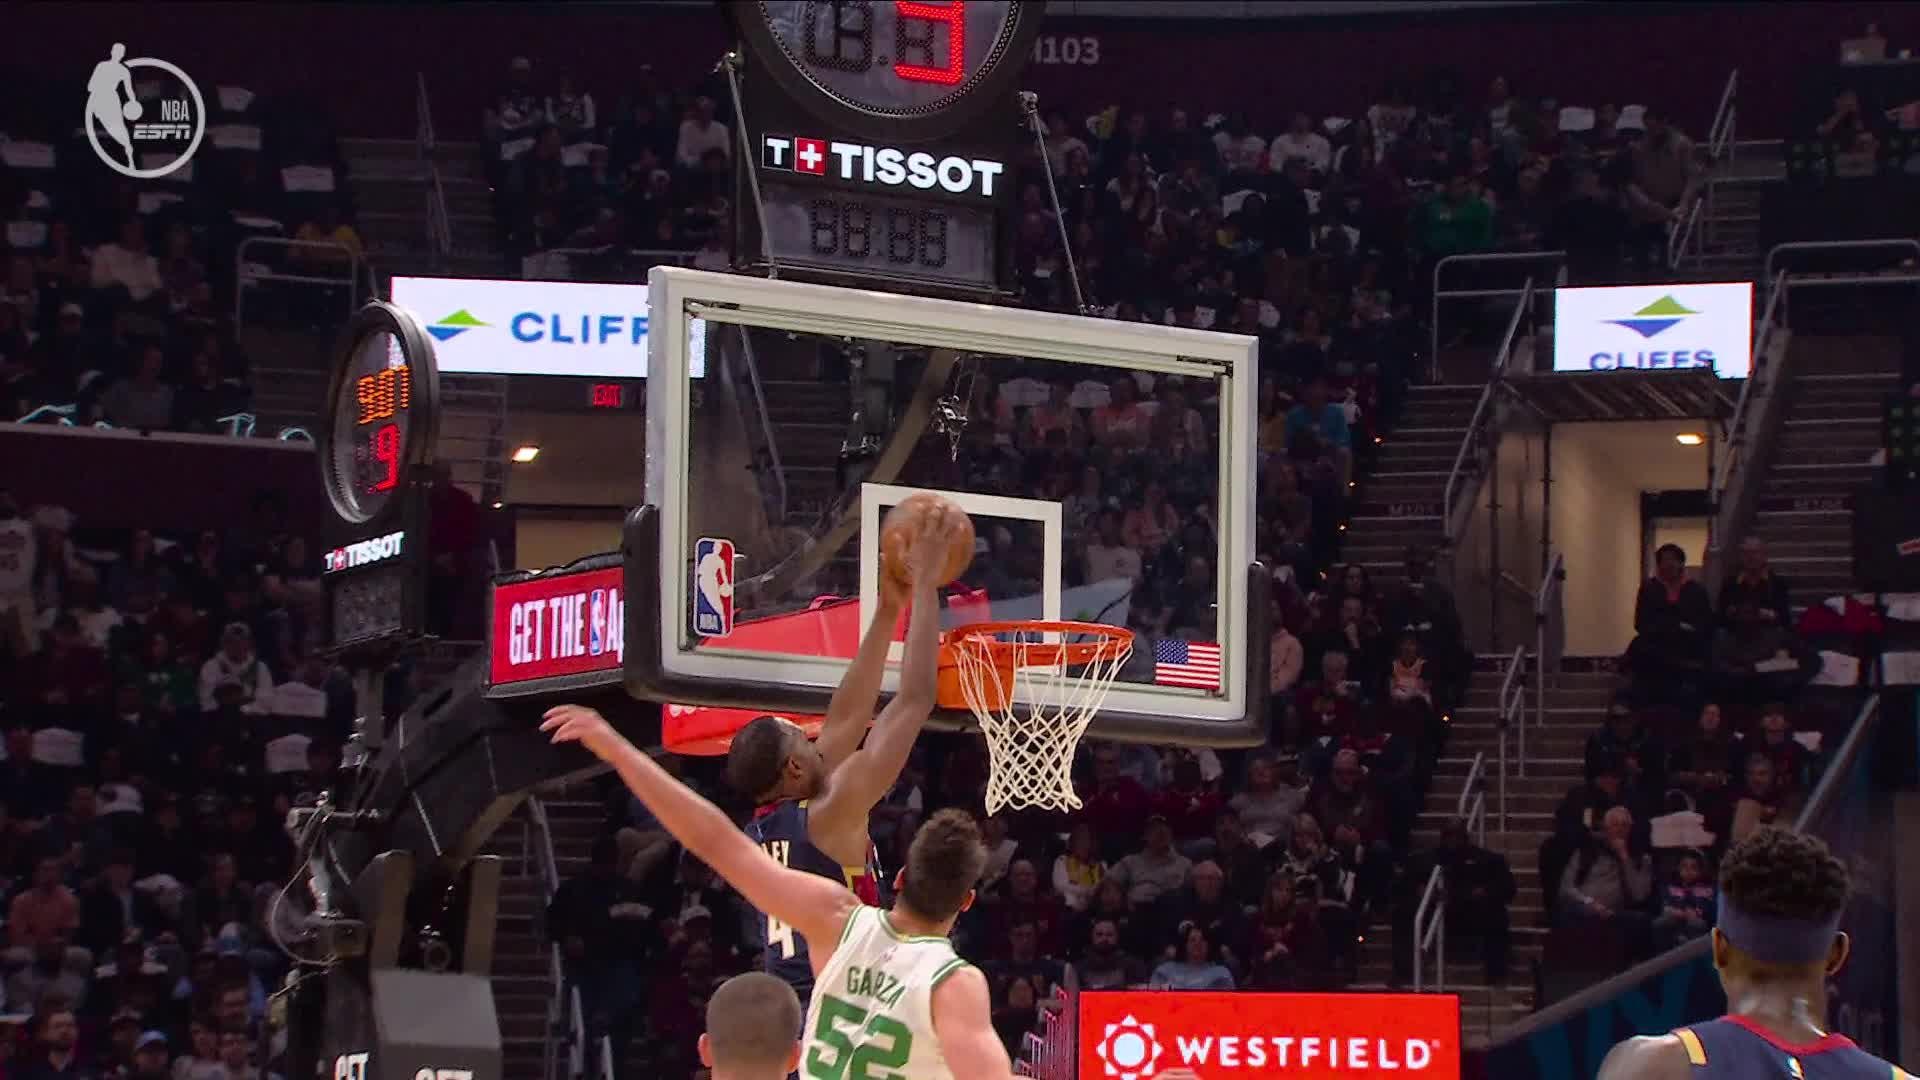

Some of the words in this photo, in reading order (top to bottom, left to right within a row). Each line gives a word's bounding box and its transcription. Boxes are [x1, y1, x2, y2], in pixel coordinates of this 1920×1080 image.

[831, 142, 1003, 197] TISSOT
[1588, 350, 1715, 371] CLIFFS
[376, 424, 399, 491] 9
[345, 531, 404, 568] TISSOT
[509, 600, 546, 665] GET
[551, 593, 586, 659] THE
[767, 914, 795, 960] 4
[847, 966, 905, 1009] GARZA
[806, 993, 913, 1080] 52
[1176, 1035, 1433, 1070] WESTFIELD
